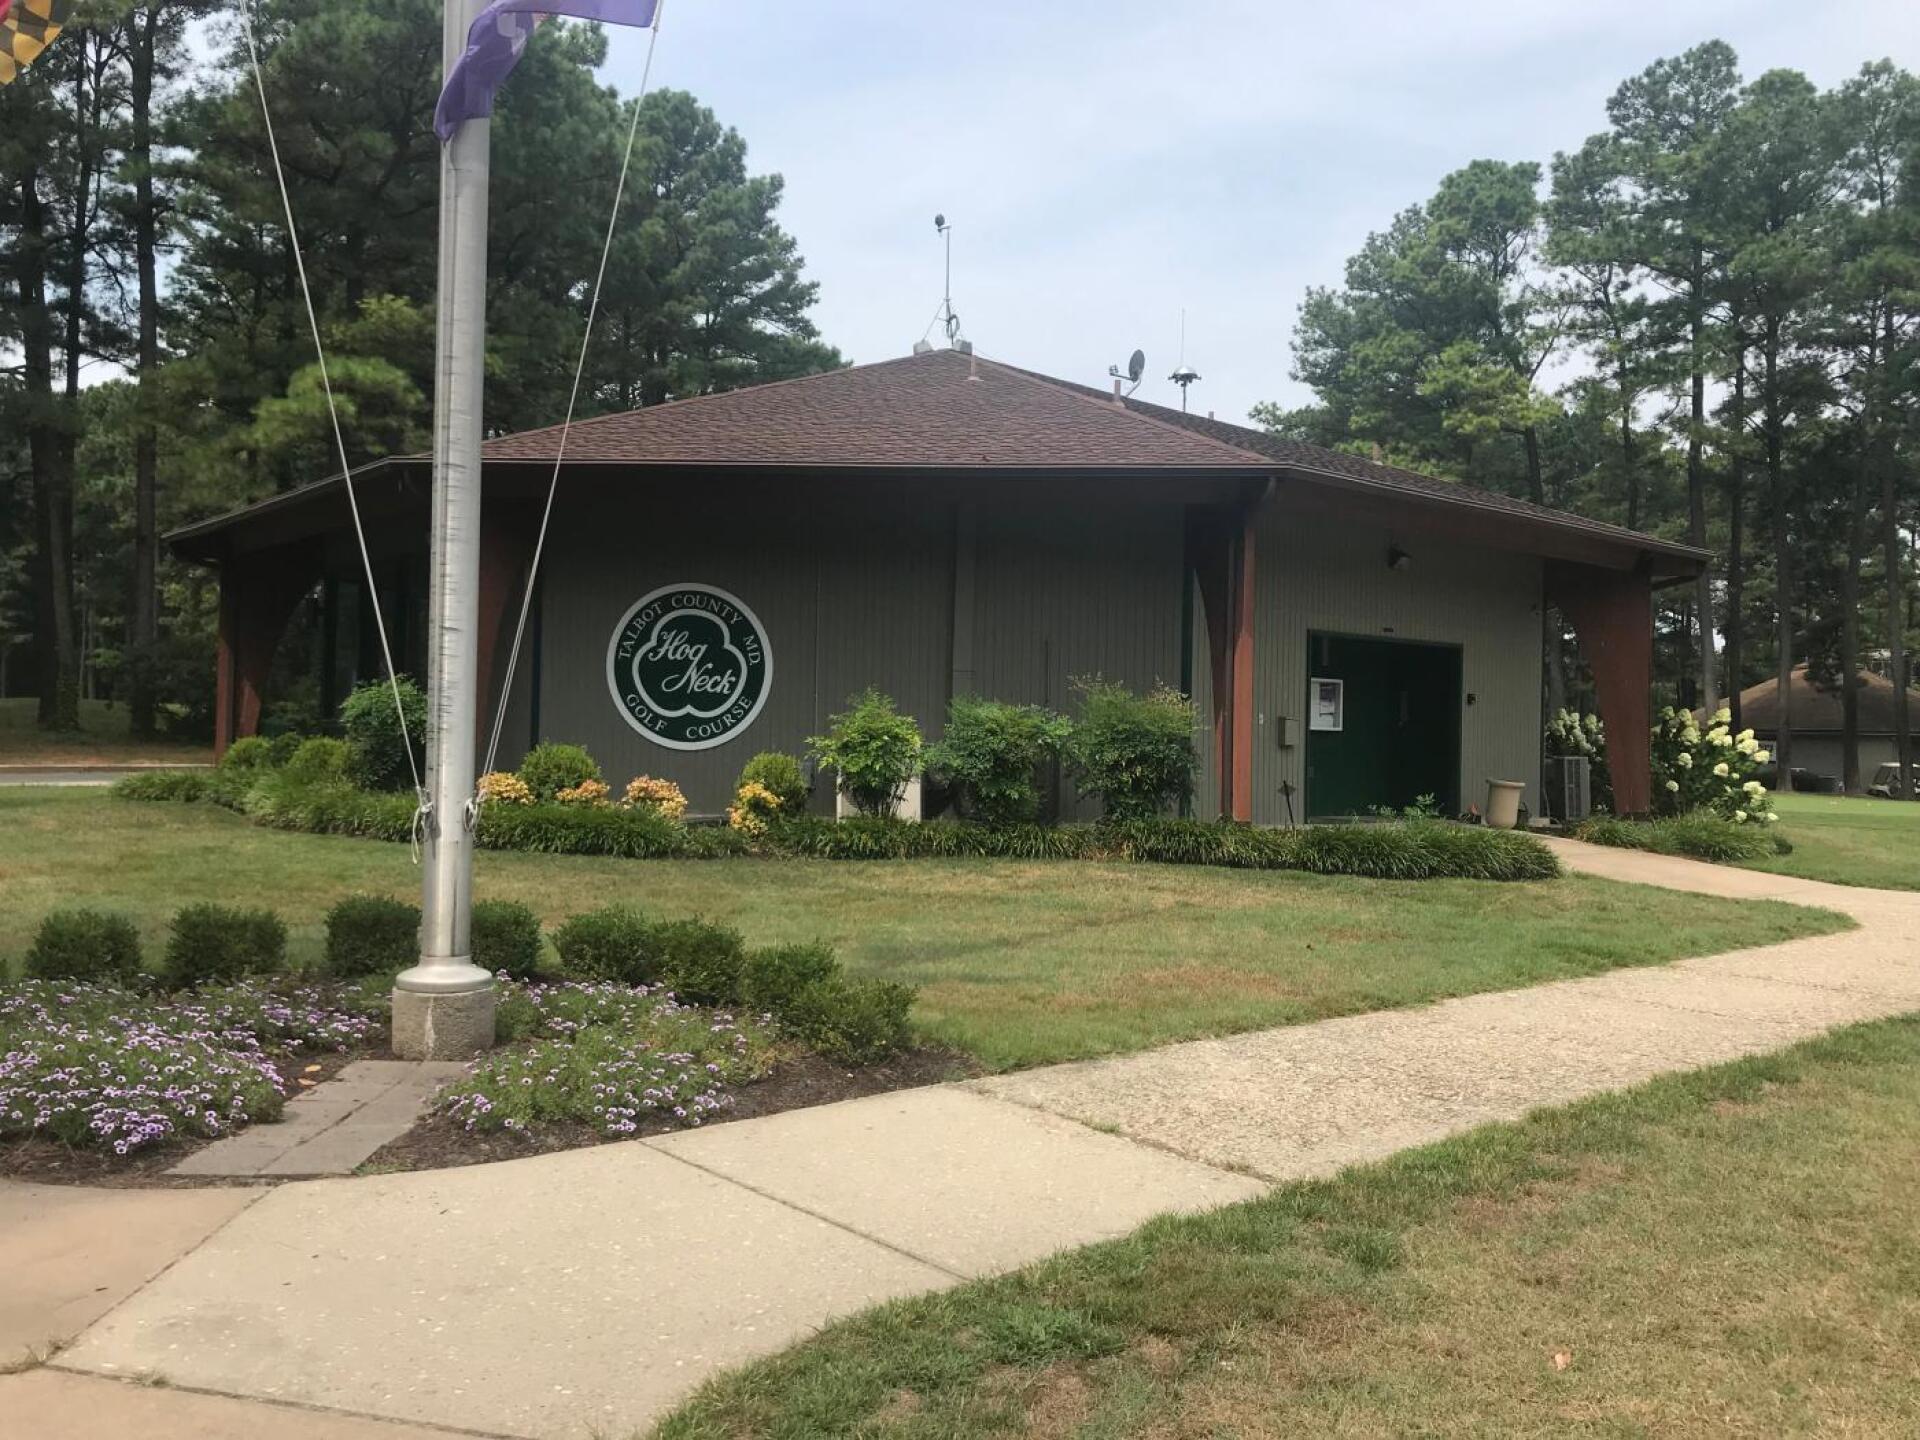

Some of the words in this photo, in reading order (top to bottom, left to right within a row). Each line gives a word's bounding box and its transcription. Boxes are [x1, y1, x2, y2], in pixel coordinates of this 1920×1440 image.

[619, 602, 662, 659] TALBOT
[672, 595, 743, 624] COUNTY
[649, 630, 708, 663] Hog
[661, 663, 735, 694] Neck
[627, 694, 668, 731] GOLF
[686, 696, 752, 738] COURSE
